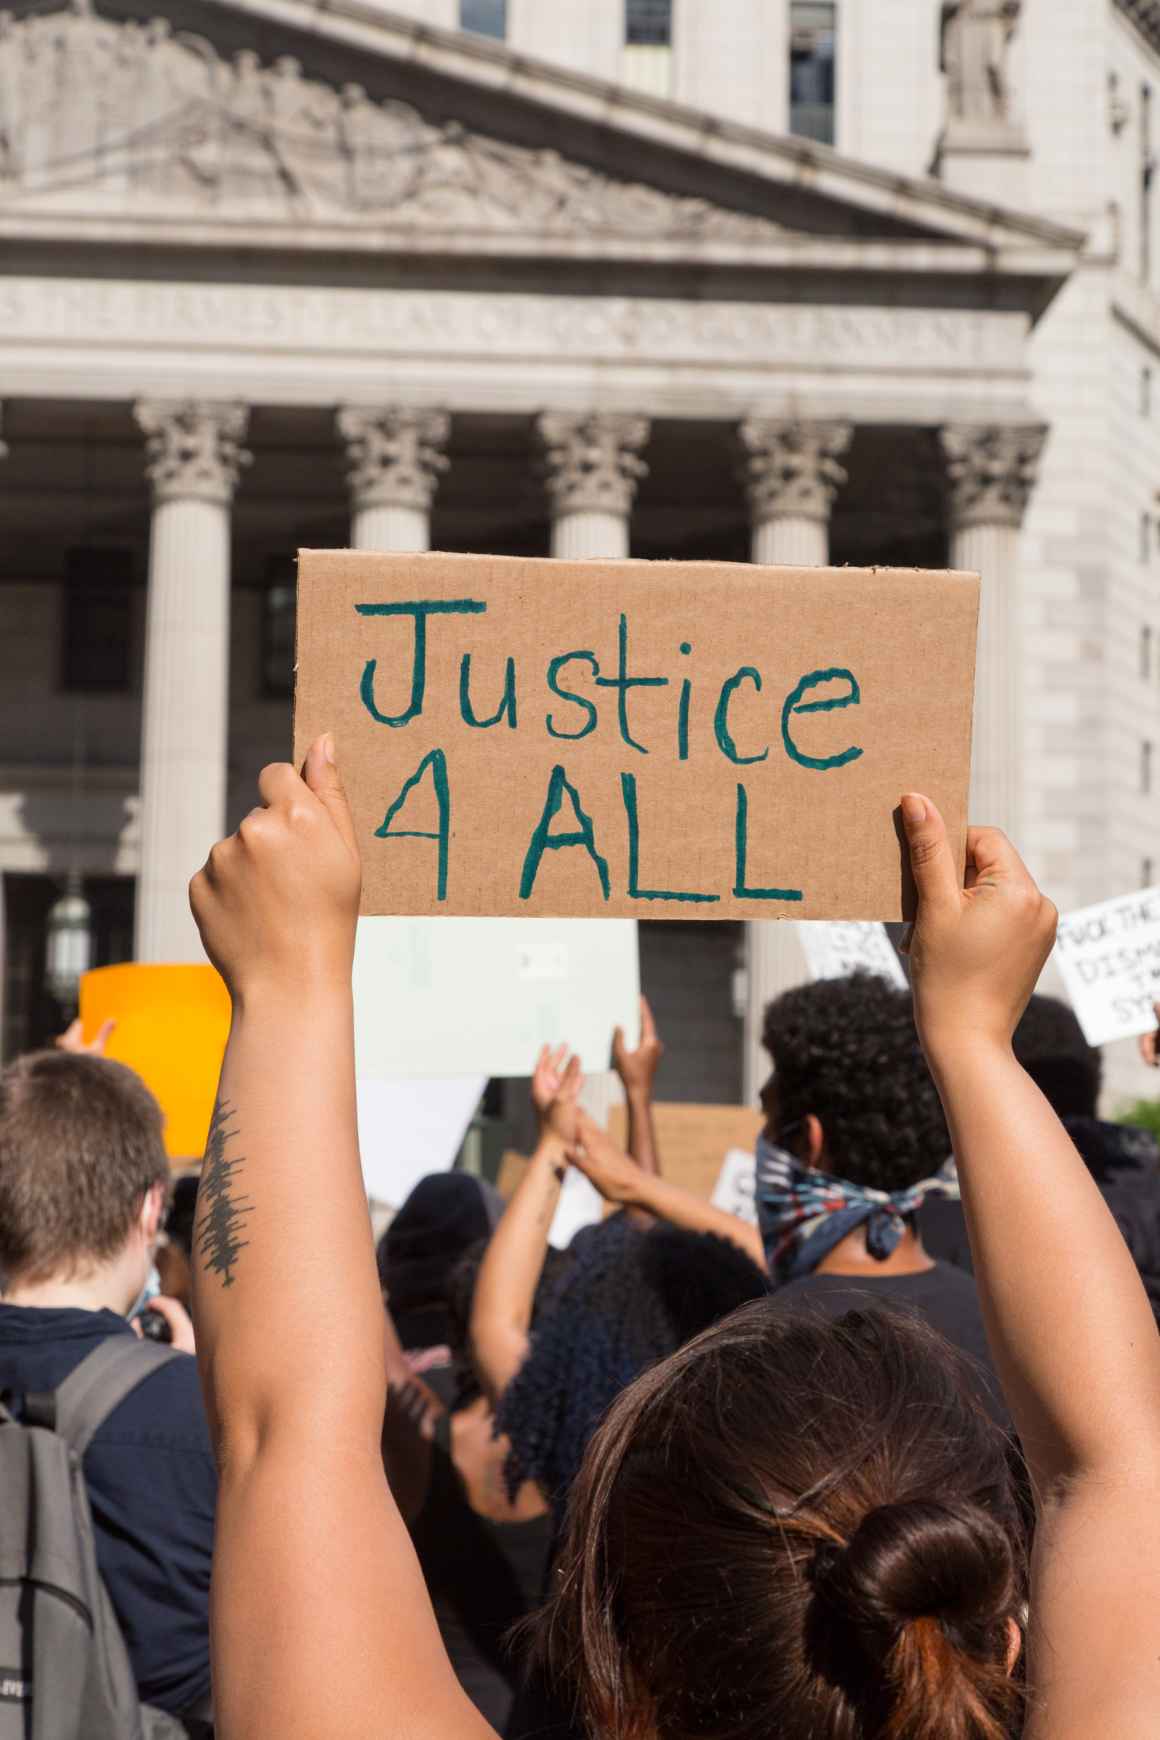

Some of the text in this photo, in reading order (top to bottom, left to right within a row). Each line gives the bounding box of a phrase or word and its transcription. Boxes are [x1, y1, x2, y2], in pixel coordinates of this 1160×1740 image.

[355, 599, 863, 769] Justice
[374, 748, 803, 902] 4 ALL
